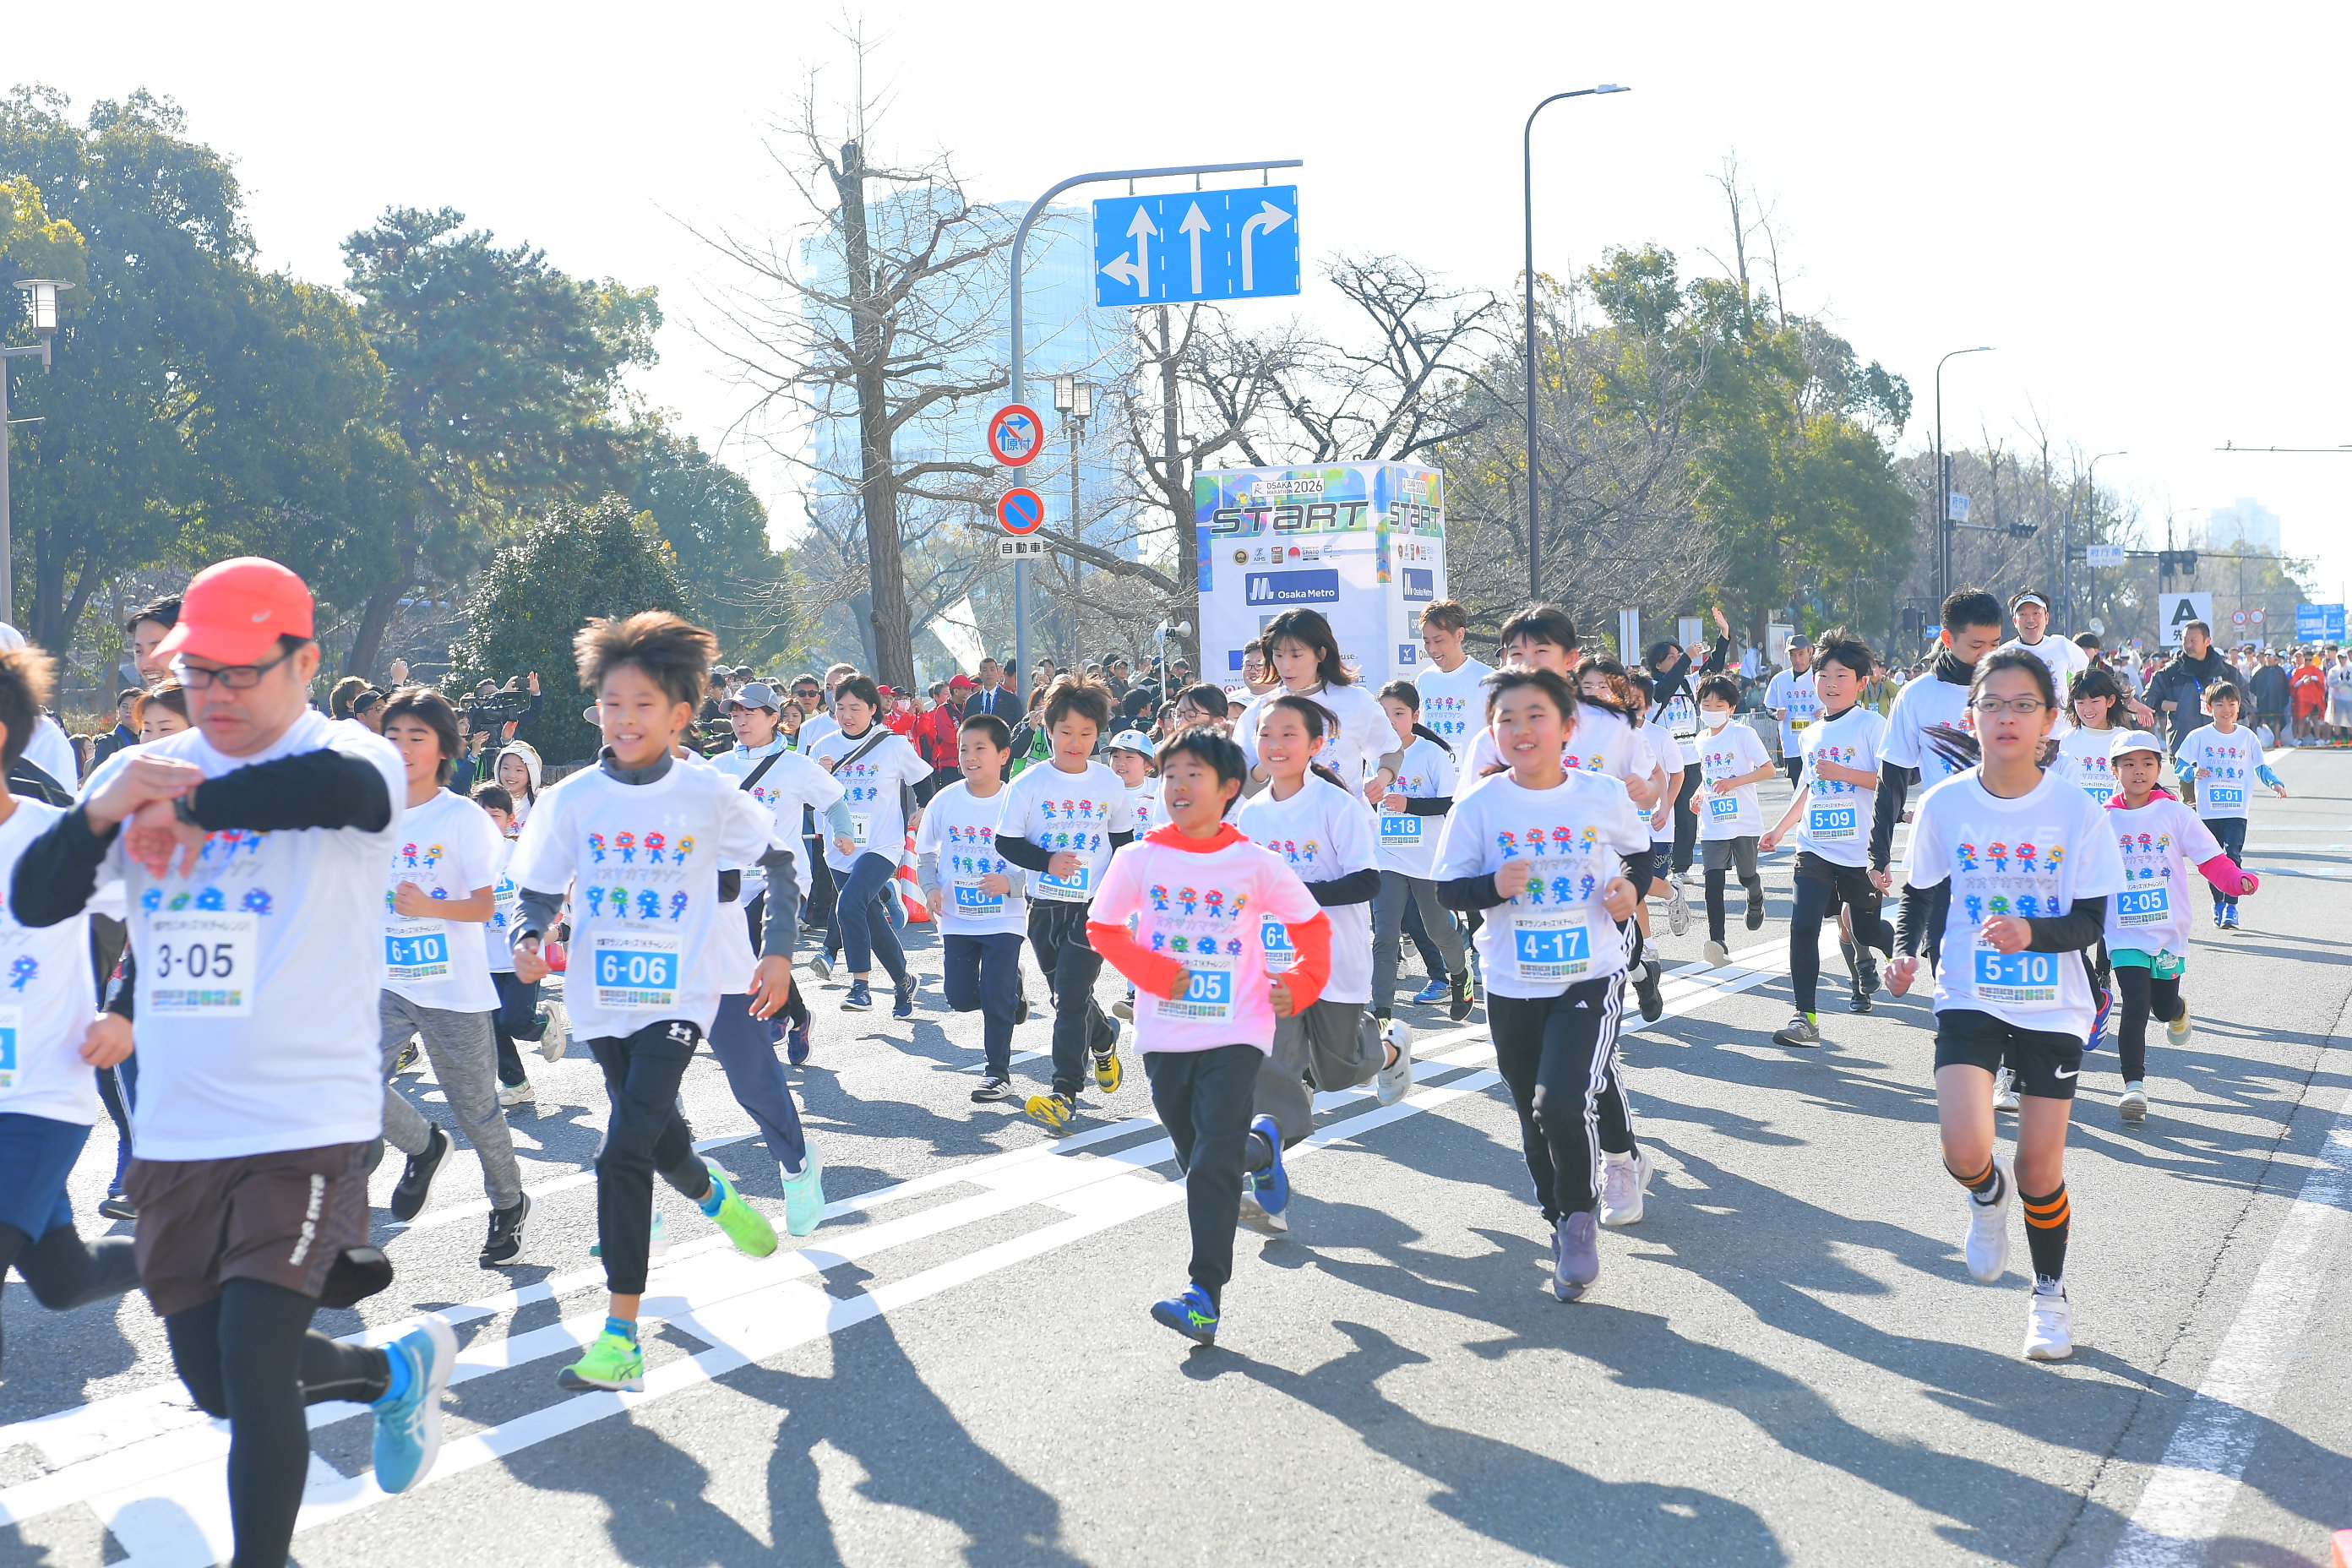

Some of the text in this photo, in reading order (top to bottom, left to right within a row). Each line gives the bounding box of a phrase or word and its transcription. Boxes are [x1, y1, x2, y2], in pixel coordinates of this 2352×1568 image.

[1006, 438, 1031, 451] 原付
[1266, 481, 1293, 490] OSAKA
[1293, 480, 1323, 493] 2026
[1002, 542, 1042, 554] 自動車
[1277, 589, 1335, 599] Osaka Metro
[2170, 598, 2199, 626] A
[2173, 629, 2183, 641] 先
[2092, 790, 2109, 803] 19
[2213, 790, 2239, 801] 3-01
[1384, 819, 1416, 834] 4-18
[1815, 811, 1850, 827] 5-09
[1957, 823, 2062, 848] NIKE
[2122, 891, 2162, 912] 2-05
[391, 938, 439, 961] 6-10
[1524, 932, 1580, 959] 4-17
[157, 943, 234, 978] 3-05
[602, 954, 667, 985] 6-06
[1984, 955, 2049, 983] 5-10
[1189, 973, 1222, 999] 05
